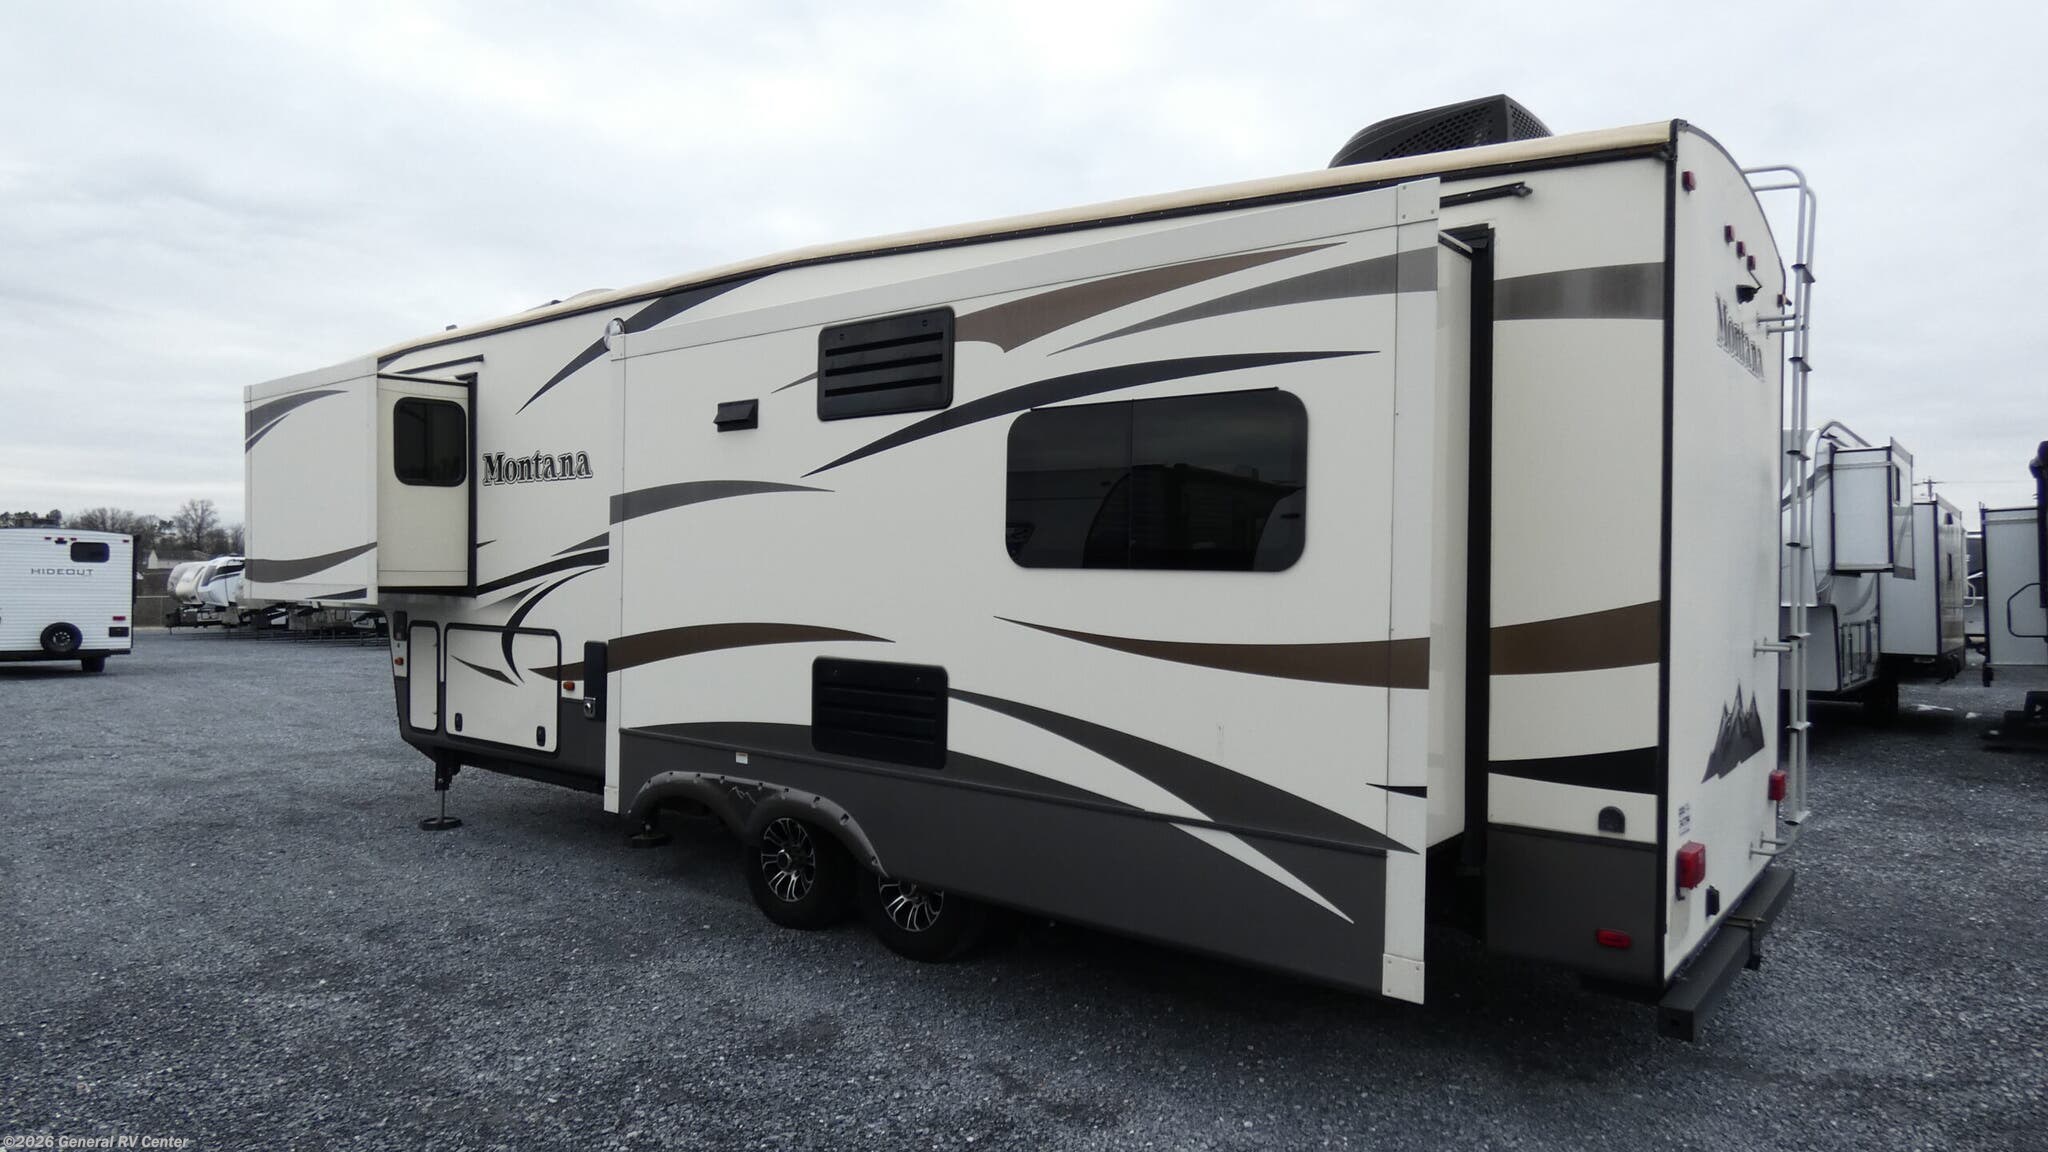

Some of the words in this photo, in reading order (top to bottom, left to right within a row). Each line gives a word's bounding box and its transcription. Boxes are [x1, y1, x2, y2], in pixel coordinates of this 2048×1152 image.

[1714, 291, 1766, 383] Montana
[482, 450, 593, 486] Montana
[30, 568, 94, 576] HIDEOUT
